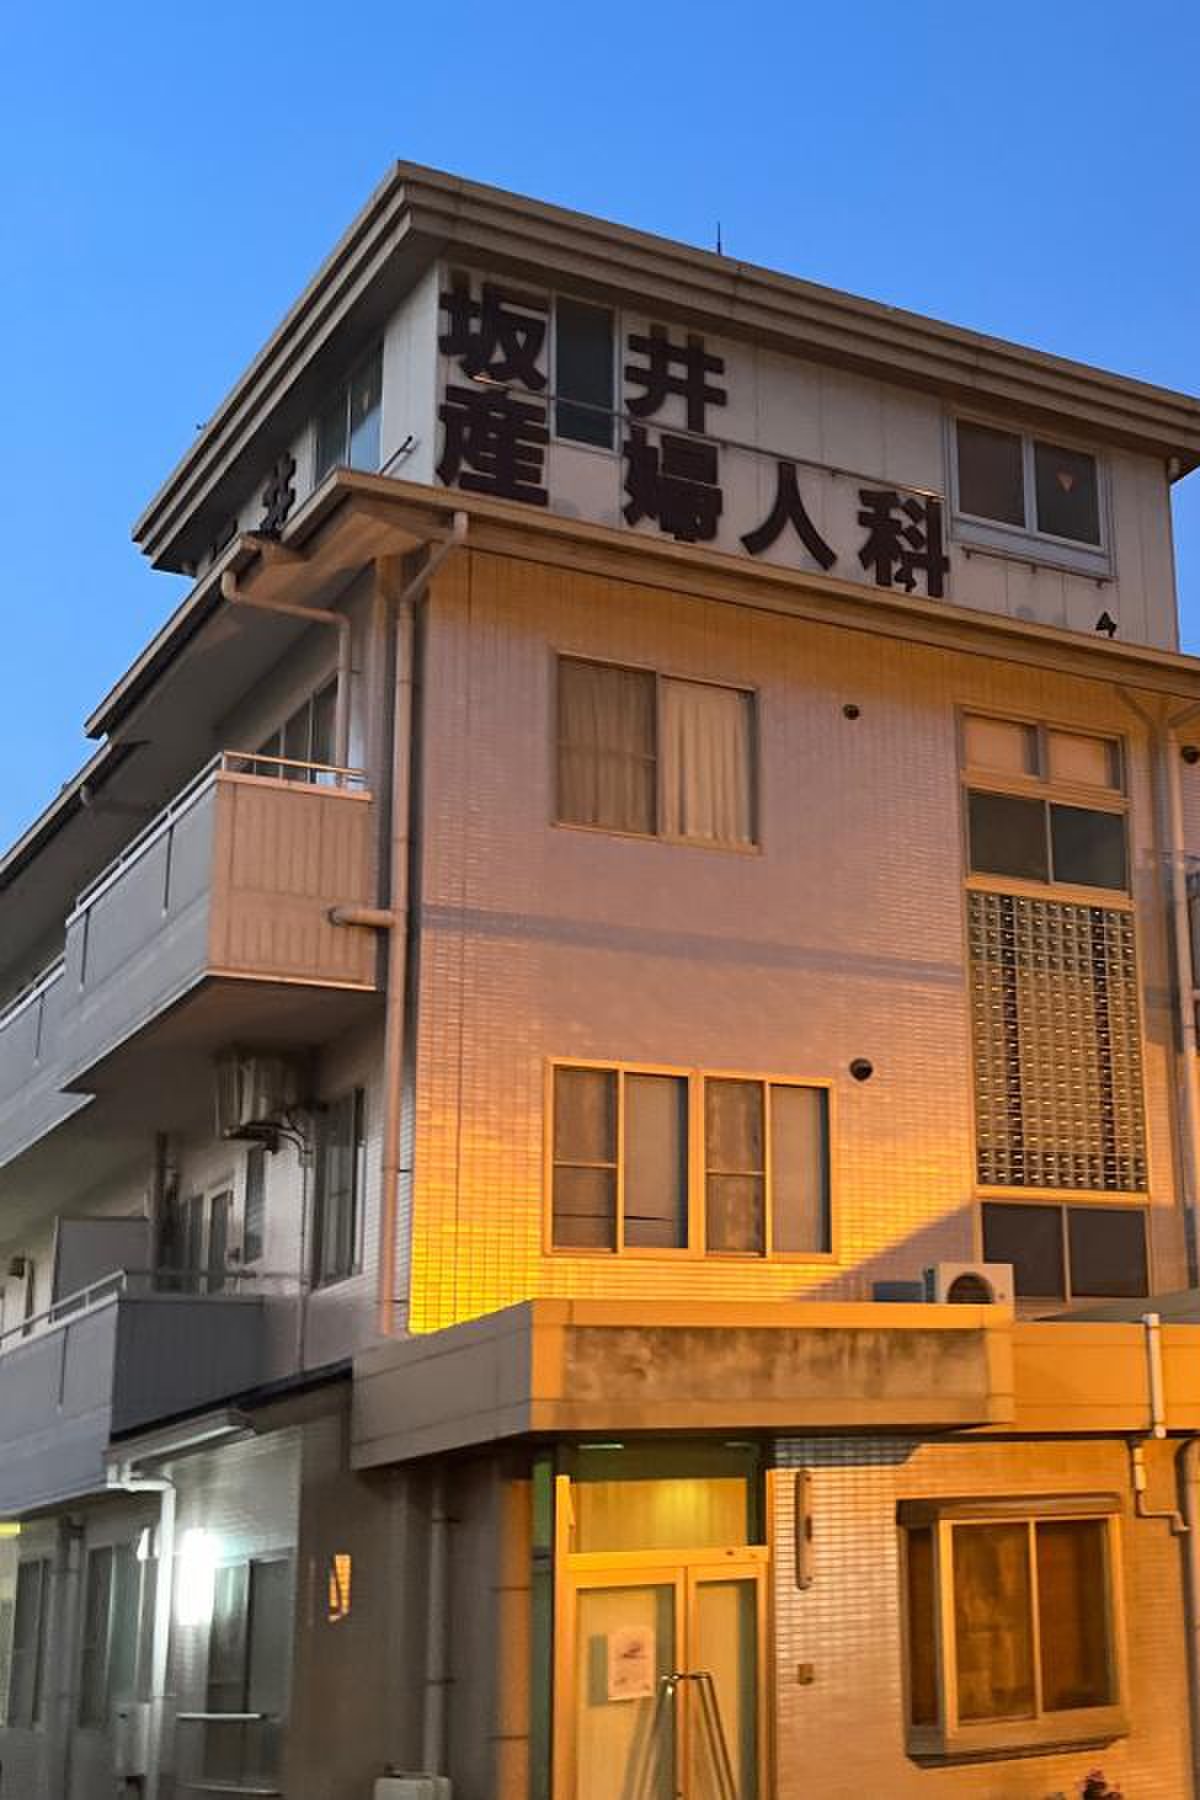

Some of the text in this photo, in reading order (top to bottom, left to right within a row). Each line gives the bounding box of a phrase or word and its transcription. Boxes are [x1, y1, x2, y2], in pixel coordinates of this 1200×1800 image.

[438, 270, 727, 434] 坂井
[436, 384, 950, 598] 産婦人科
